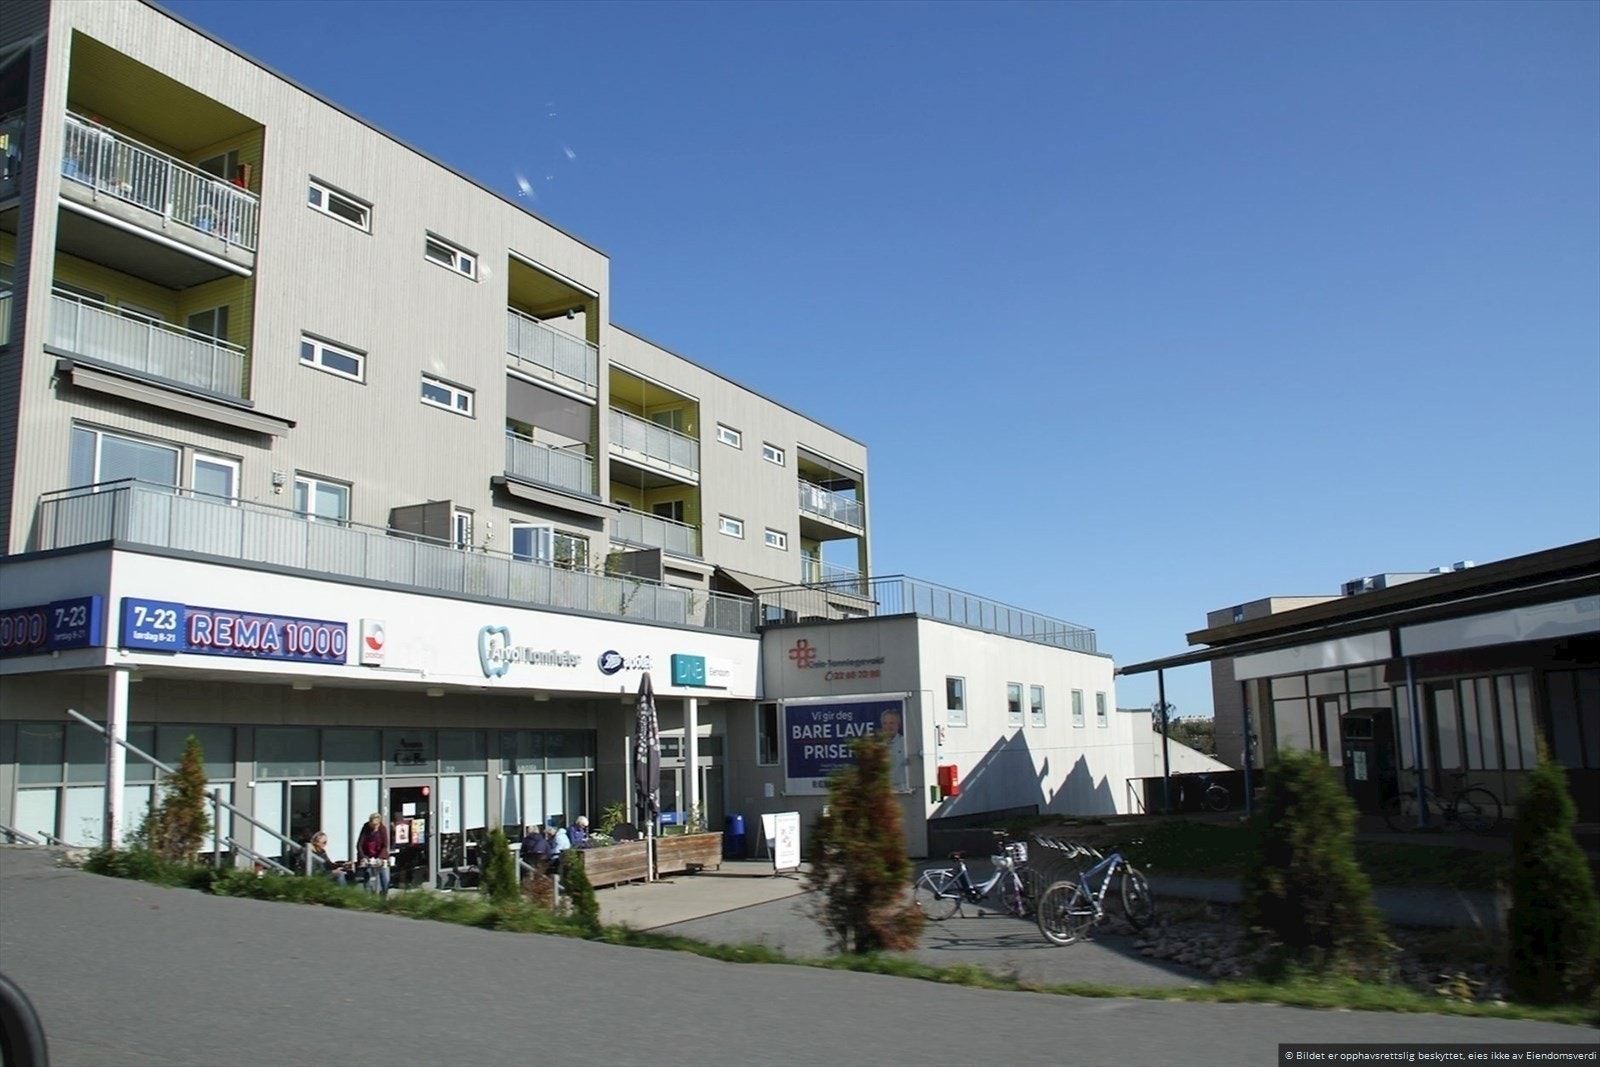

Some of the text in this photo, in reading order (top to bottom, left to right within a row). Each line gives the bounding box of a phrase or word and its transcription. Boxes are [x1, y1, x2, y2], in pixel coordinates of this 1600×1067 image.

[55, 606, 87, 628] 7-23
[133, 607, 177, 630] 7-23
[159, 633, 176, 643] 8-21
[188, 614, 346, 656] REMA 1000
[811, 710, 853, 723] Vi gir deg
[792, 722, 875, 739] BARE LAVE
